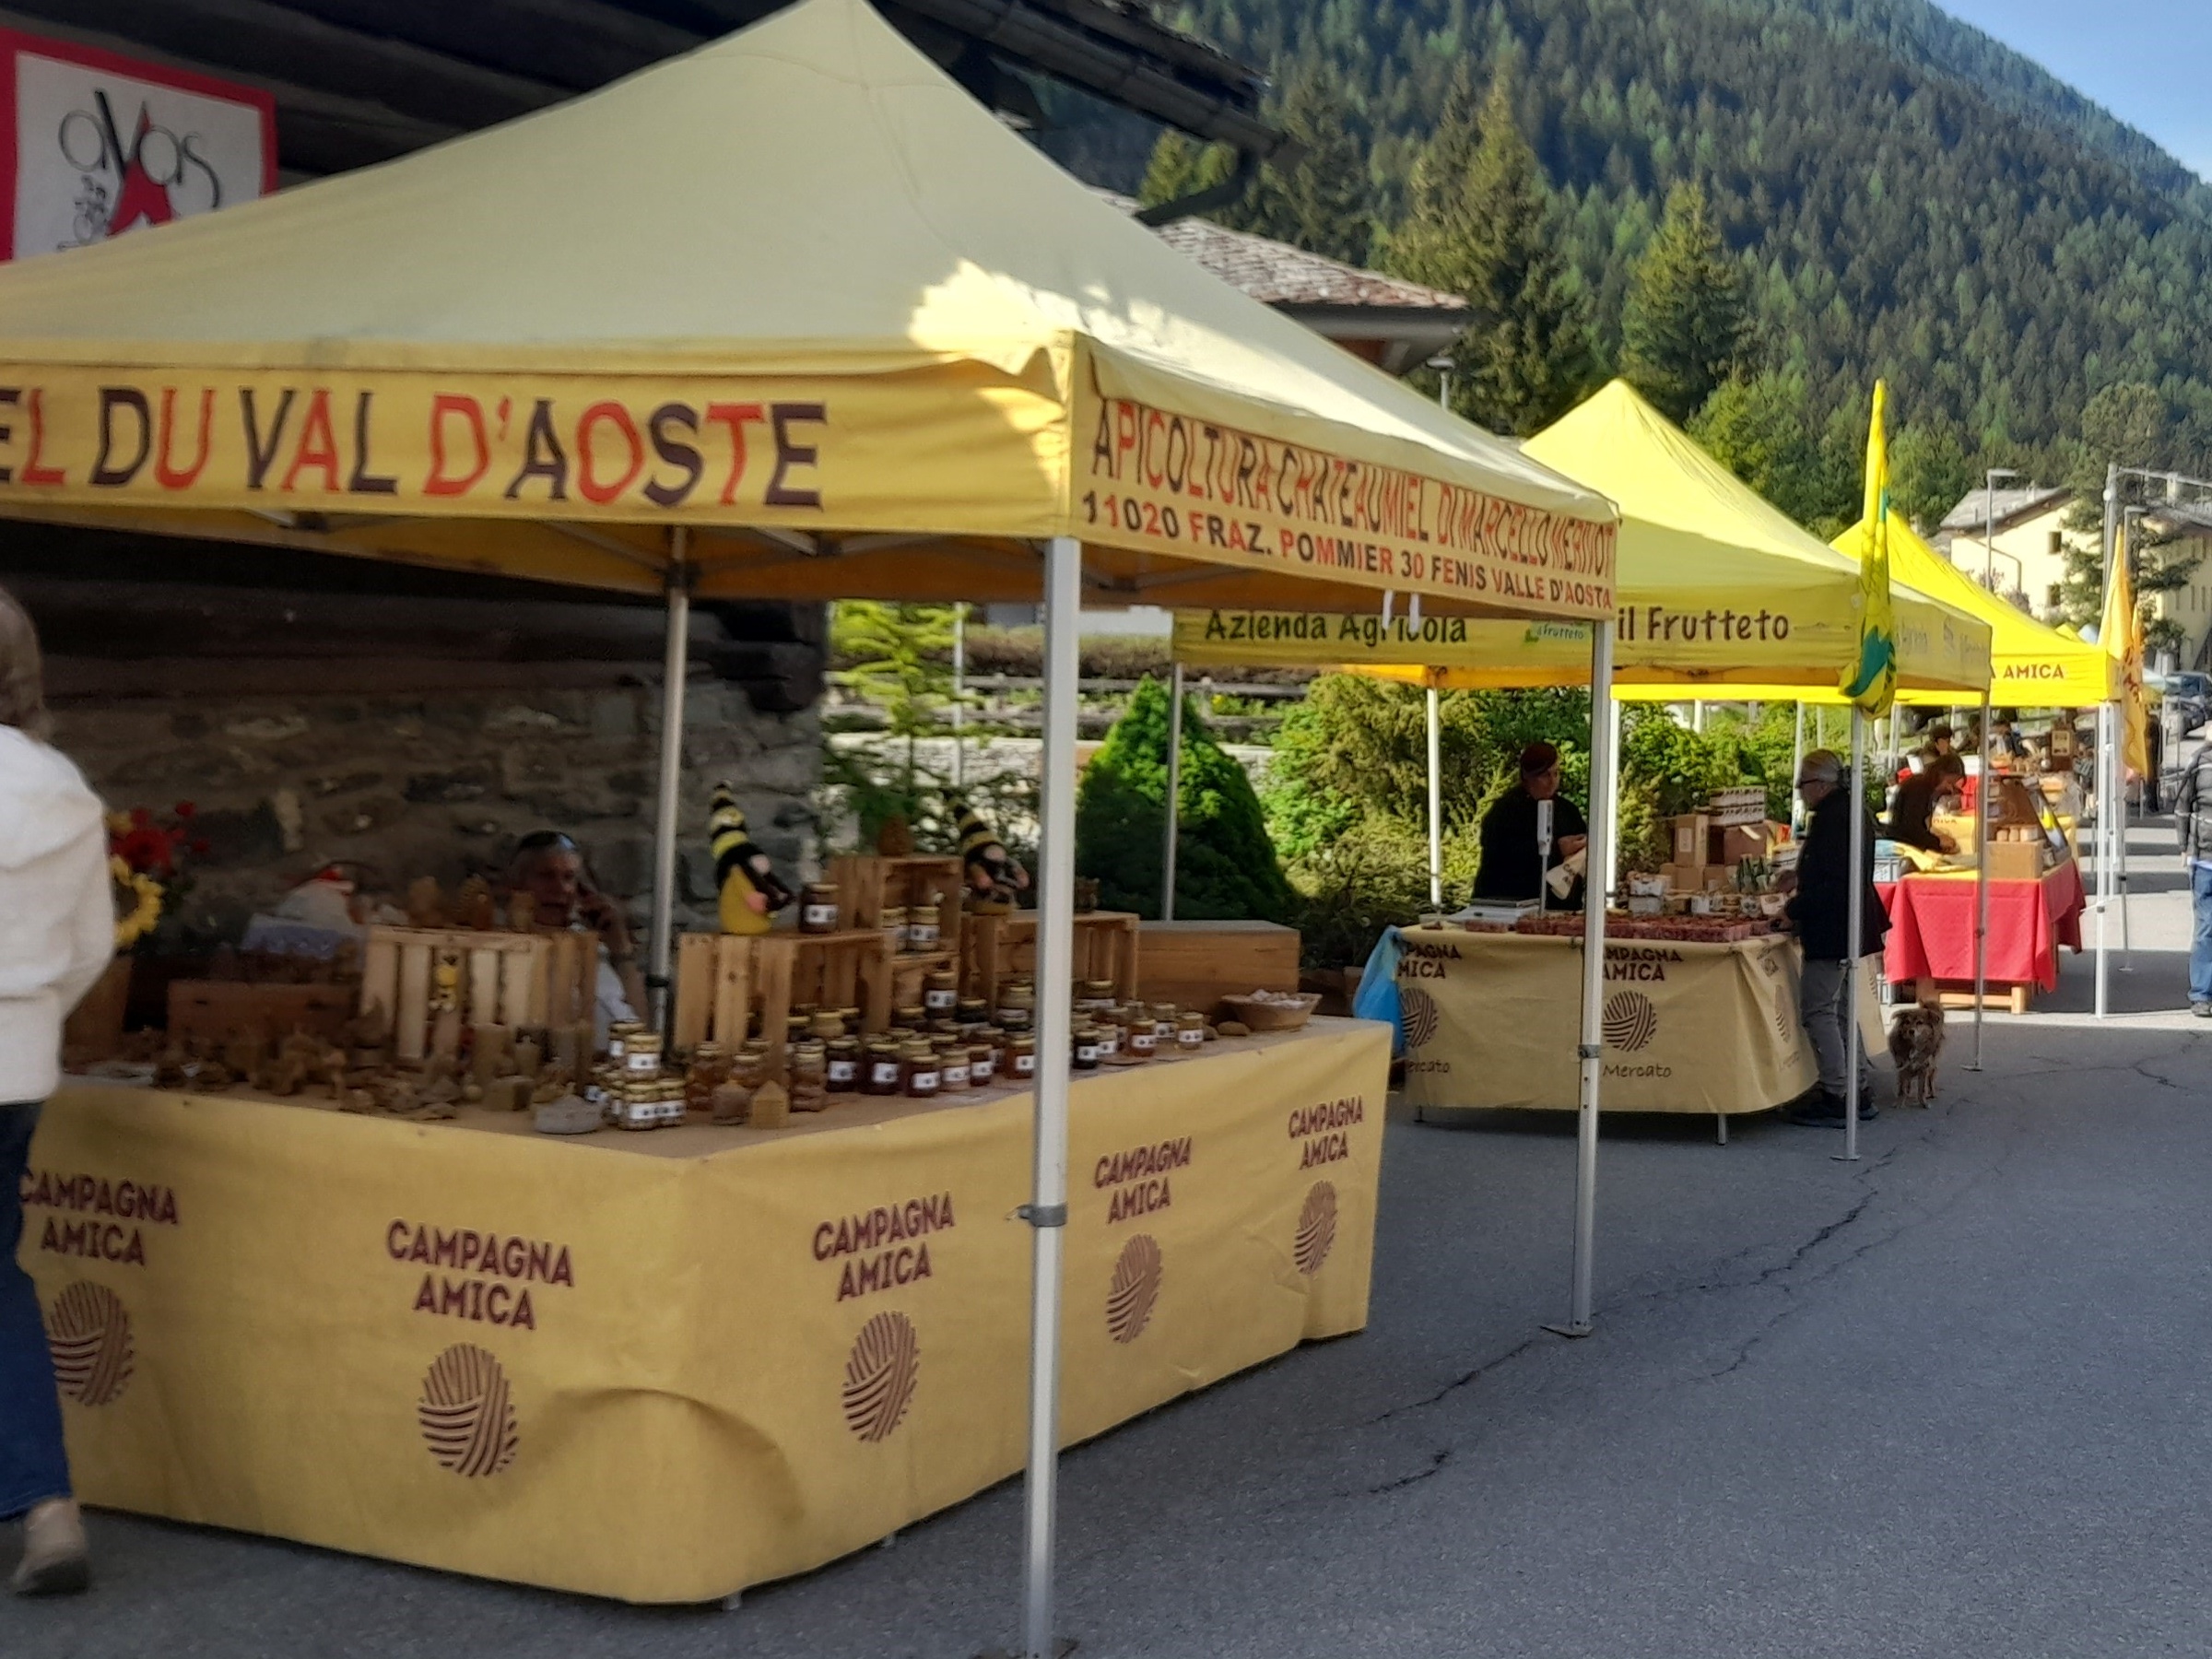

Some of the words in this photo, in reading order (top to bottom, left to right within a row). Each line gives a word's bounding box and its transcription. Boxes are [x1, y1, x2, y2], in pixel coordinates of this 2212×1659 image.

[89, 386, 214, 490] DU
[238, 387, 397, 495] VAL
[422, 394, 826, 508] D'AOSTE
[1083, 489, 1181, 539] 11020
[1188, 510, 1273, 556] FRAZ.
[1278, 528, 1394, 575] POMMIER
[1401, 550, 1425, 581] 30
[1431, 554, 1488, 591] FENIS
[1490, 567, 1546, 600] VALLE
[1549, 579, 1613, 611] D'AOSTA
[1206, 610, 1327, 641] Azienda
[1617, 608, 1634, 641] il
[1648, 606, 1789, 641] Frutteto
[2003, 664, 2065, 679] AMICA
[1397, 960, 1446, 979] MICA
[1603, 946, 1684, 962] MPAGNA
[1407, 1062, 1451, 1074] ercato
[1603, 1065, 1672, 1078] Mercato
[1289, 1097, 1363, 1139] CAMPAGNA
[1093, 1136, 1192, 1189] CAMPAGNA
[1300, 1133, 1348, 1171] AMICA
[18, 1167, 178, 1225] CAMPAGNA
[1108, 1177, 1171, 1225] AMICA
[41, 1217, 145, 1266] AMICA
[813, 1192, 956, 1262] CAMPAGNA
[387, 1217, 575, 1288] CAMPAGNA
[837, 1241, 933, 1302] AMICA
[414, 1272, 536, 1330] AMICA
